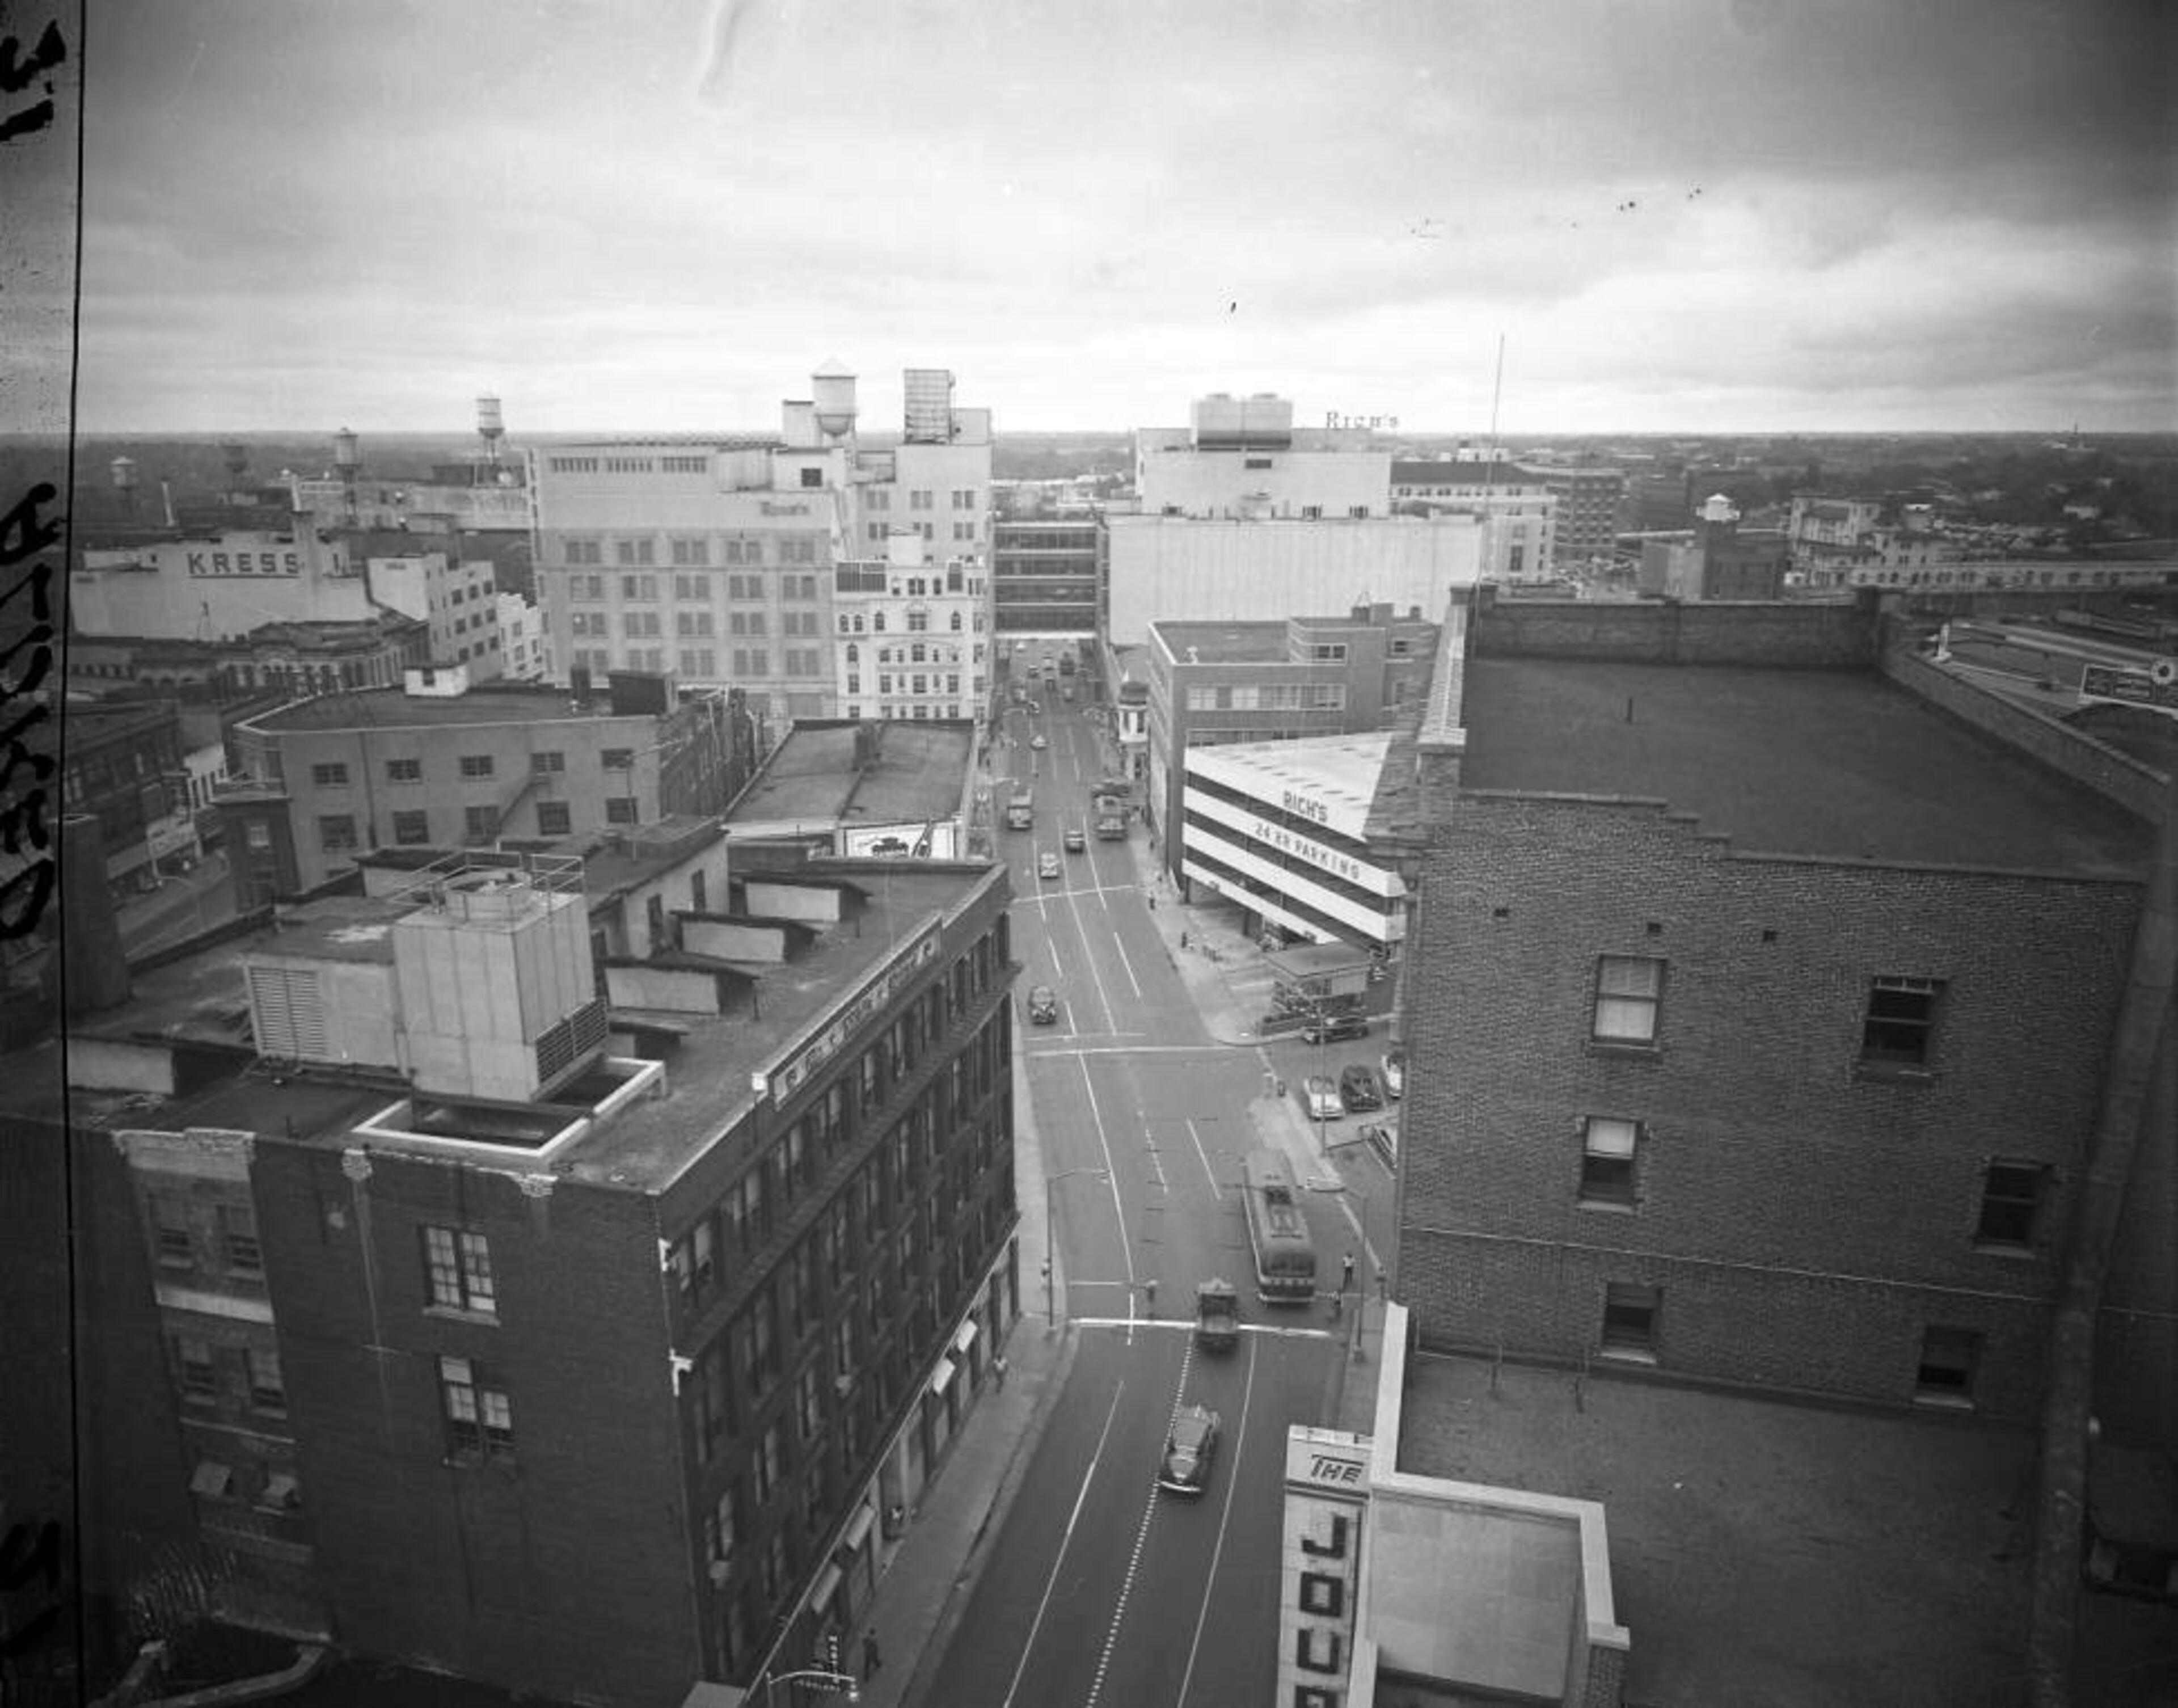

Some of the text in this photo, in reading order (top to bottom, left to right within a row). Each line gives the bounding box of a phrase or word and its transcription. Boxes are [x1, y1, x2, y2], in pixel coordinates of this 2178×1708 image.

[186, 553, 299, 574] KRESS
[1284, 790, 1328, 823] RICH'S
[1255, 823, 1270, 838] 24
[1295, 840, 1360, 879] PARKING
[1311, 1453, 1364, 1483] THE
